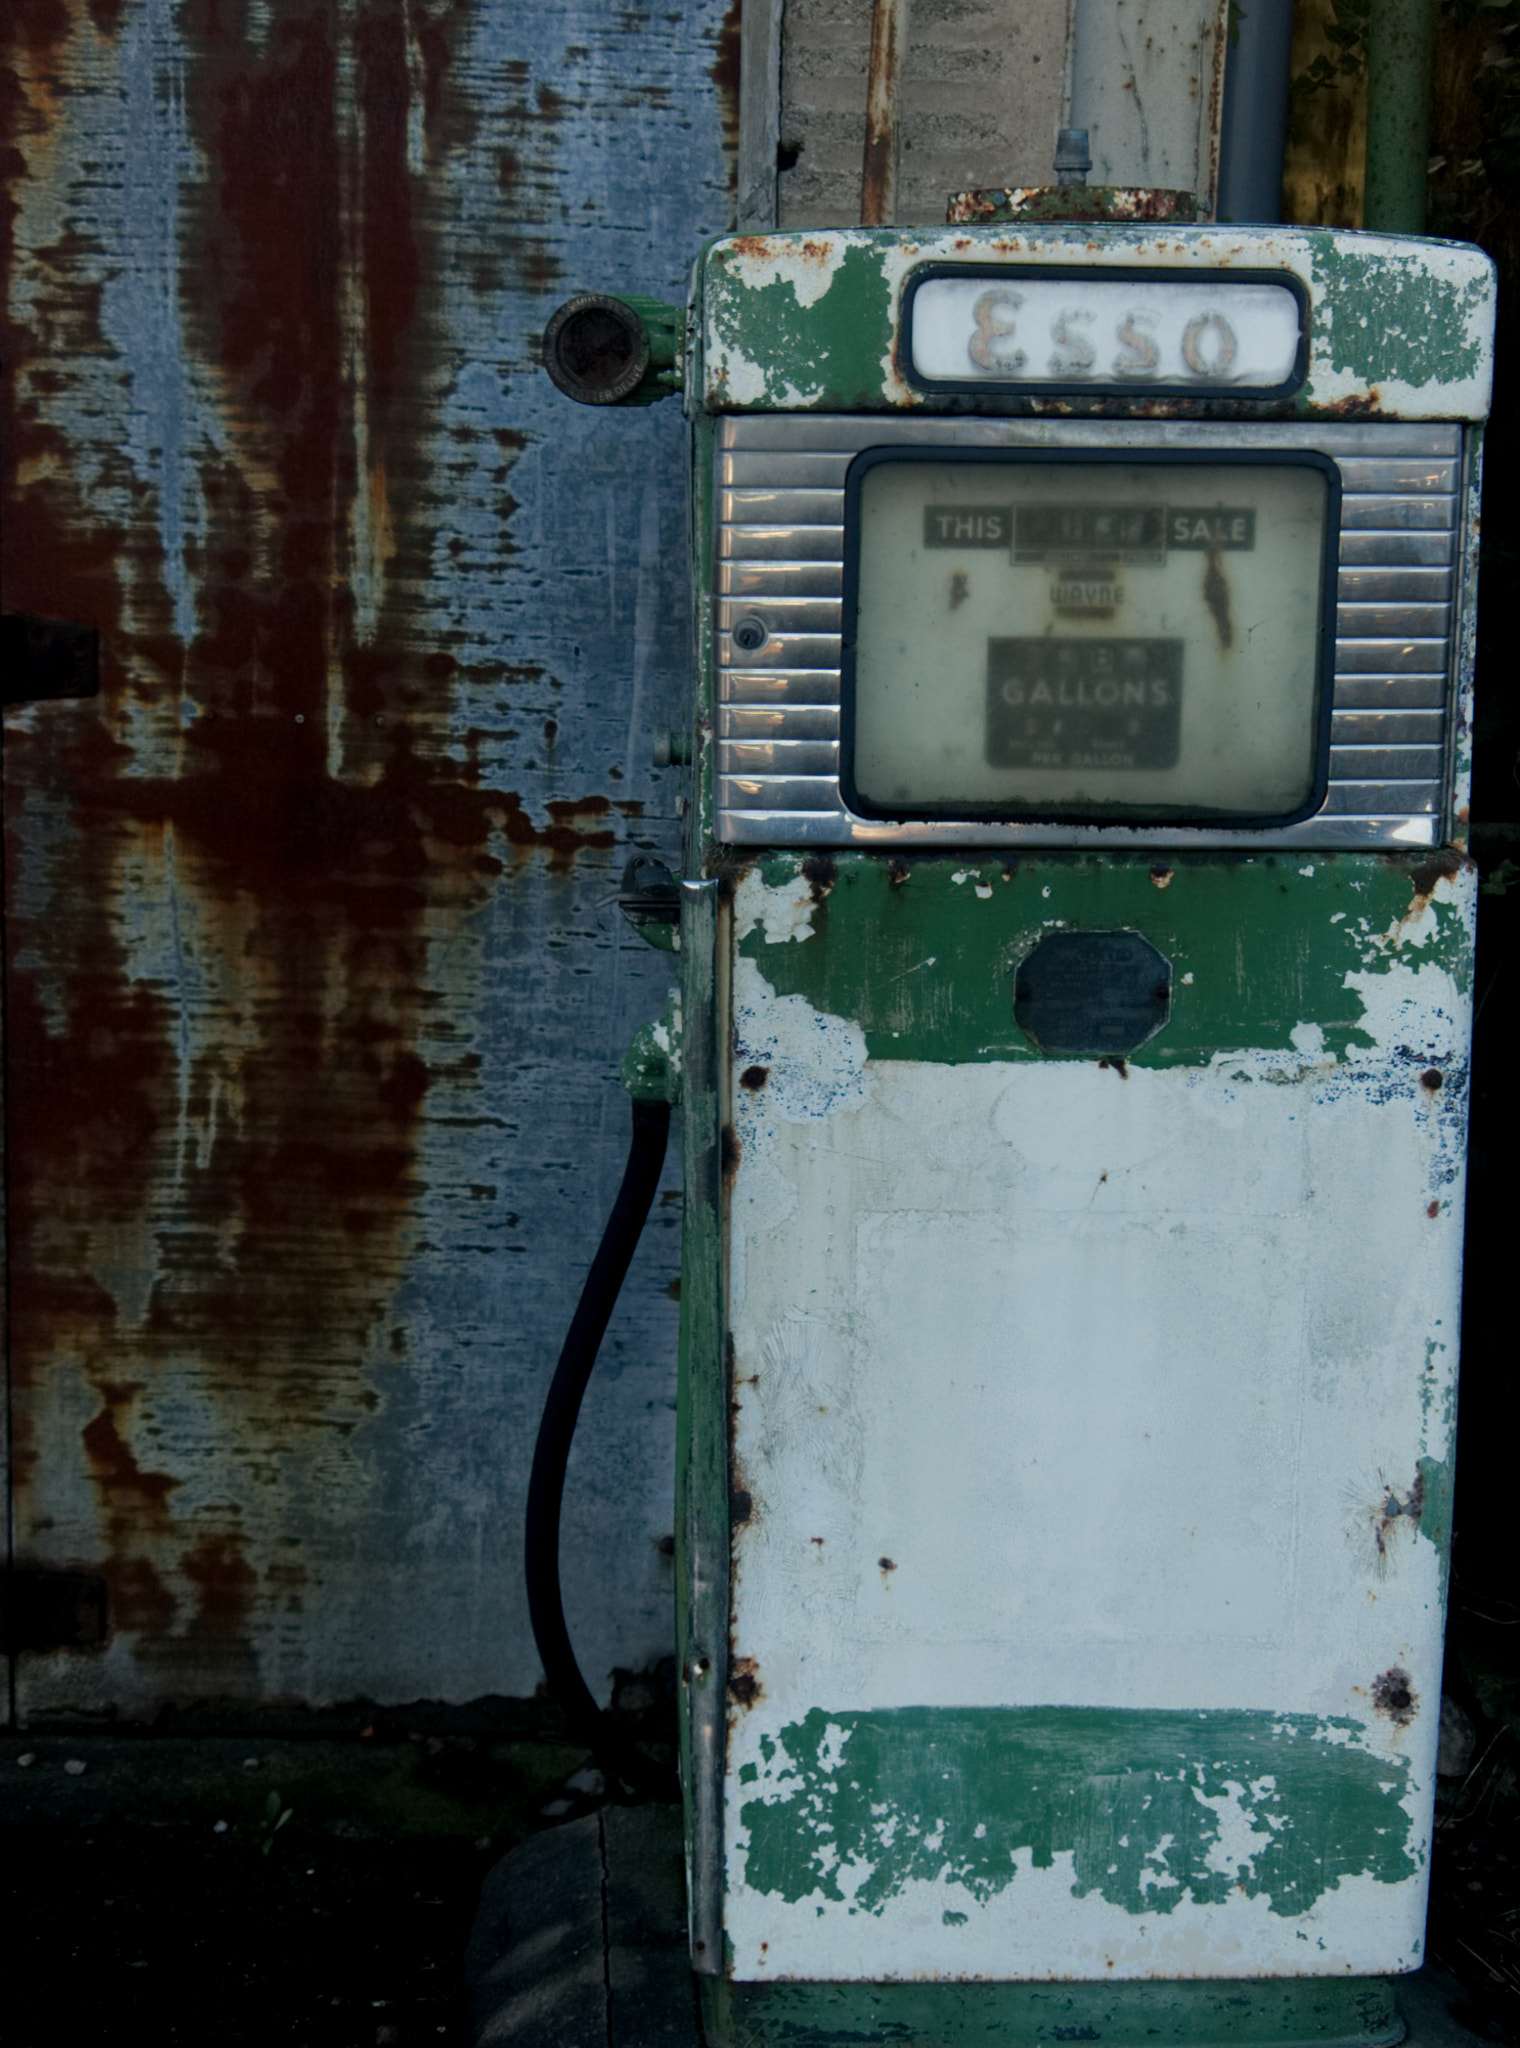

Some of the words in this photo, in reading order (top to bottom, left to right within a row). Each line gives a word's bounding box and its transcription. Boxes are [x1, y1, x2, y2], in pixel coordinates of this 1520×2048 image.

[936, 514, 1003, 540] THIS
[1173, 518, 1246, 542] SALE
[1002, 681, 1169, 707] GALLONS
[1070, 753, 1134, 766] GALLON
